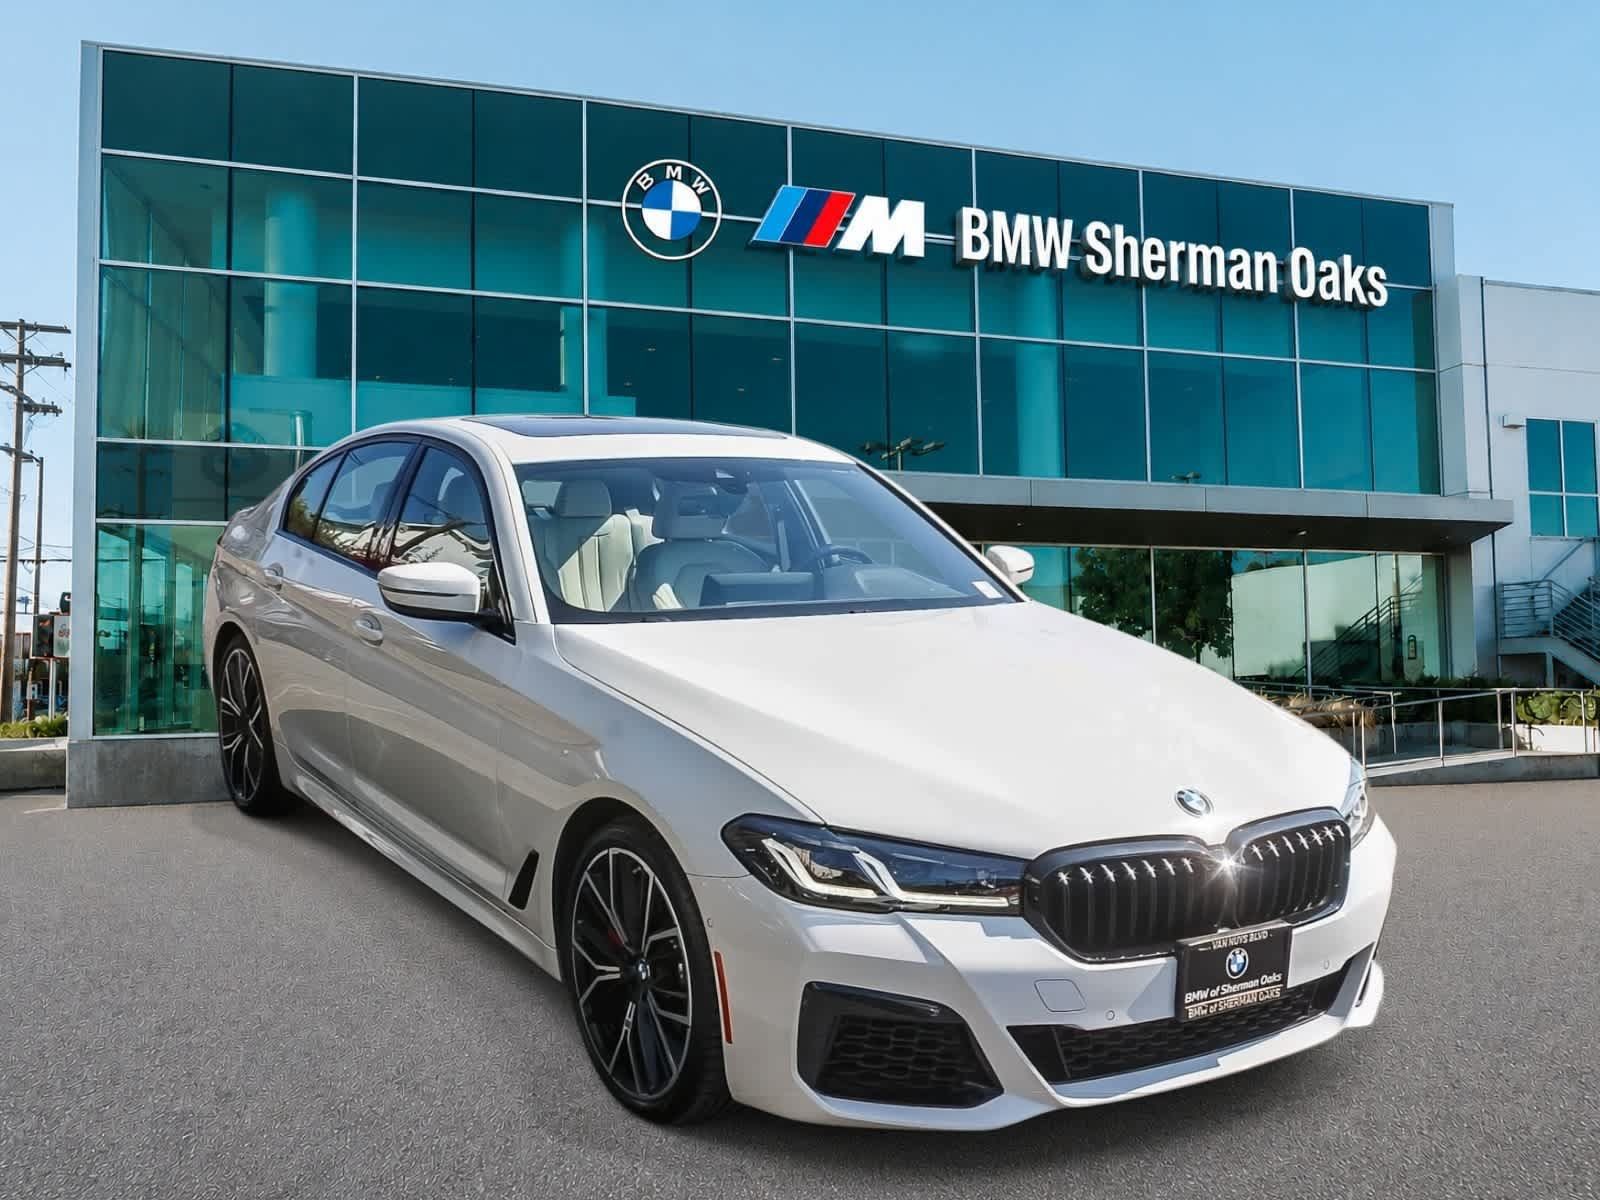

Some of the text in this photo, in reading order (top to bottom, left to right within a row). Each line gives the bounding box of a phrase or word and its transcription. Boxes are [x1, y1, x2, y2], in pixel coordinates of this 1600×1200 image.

[636, 165, 711, 195] BMW
[835, 195, 925, 257] M
[960, 206, 1389, 307] BMW Sherman Oaks
[1212, 939, 1228, 950] VAN
[1249, 931, 1268, 942] BLVD
[1184, 972, 1282, 1004] BMW of Sherman Oaks
[1209, 1001, 1218, 1013] of
[1218, 993, 1257, 1011] SHERMAN
[1258, 988, 1281, 1001] OAKS
